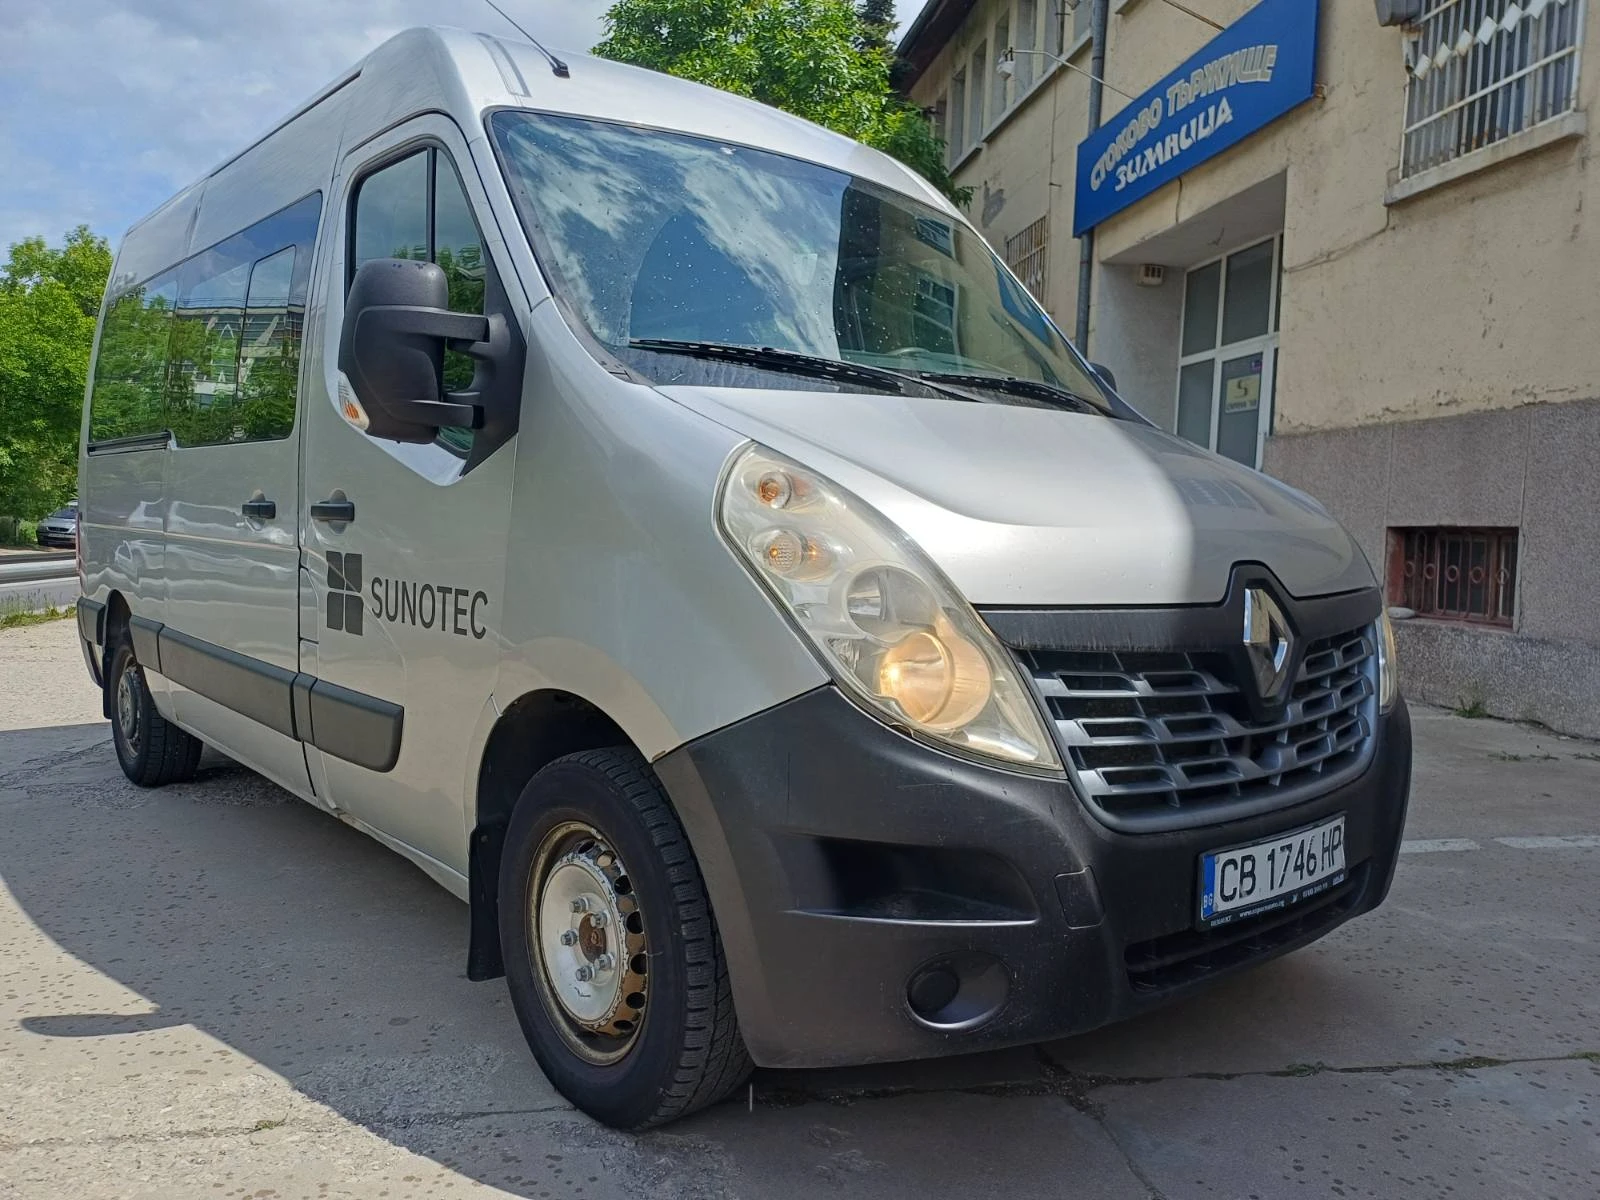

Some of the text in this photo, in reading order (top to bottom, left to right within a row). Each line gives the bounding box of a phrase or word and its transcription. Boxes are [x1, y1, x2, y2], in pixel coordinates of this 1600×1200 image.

[1090, 44, 1278, 192] СТОКОВО ТЪРЖИЩЕ
[371, 576, 489, 640] SUNOTEC
[1220, 826, 1341, 902] CB 1746 HP
[1204, 892, 1213, 908] BG
